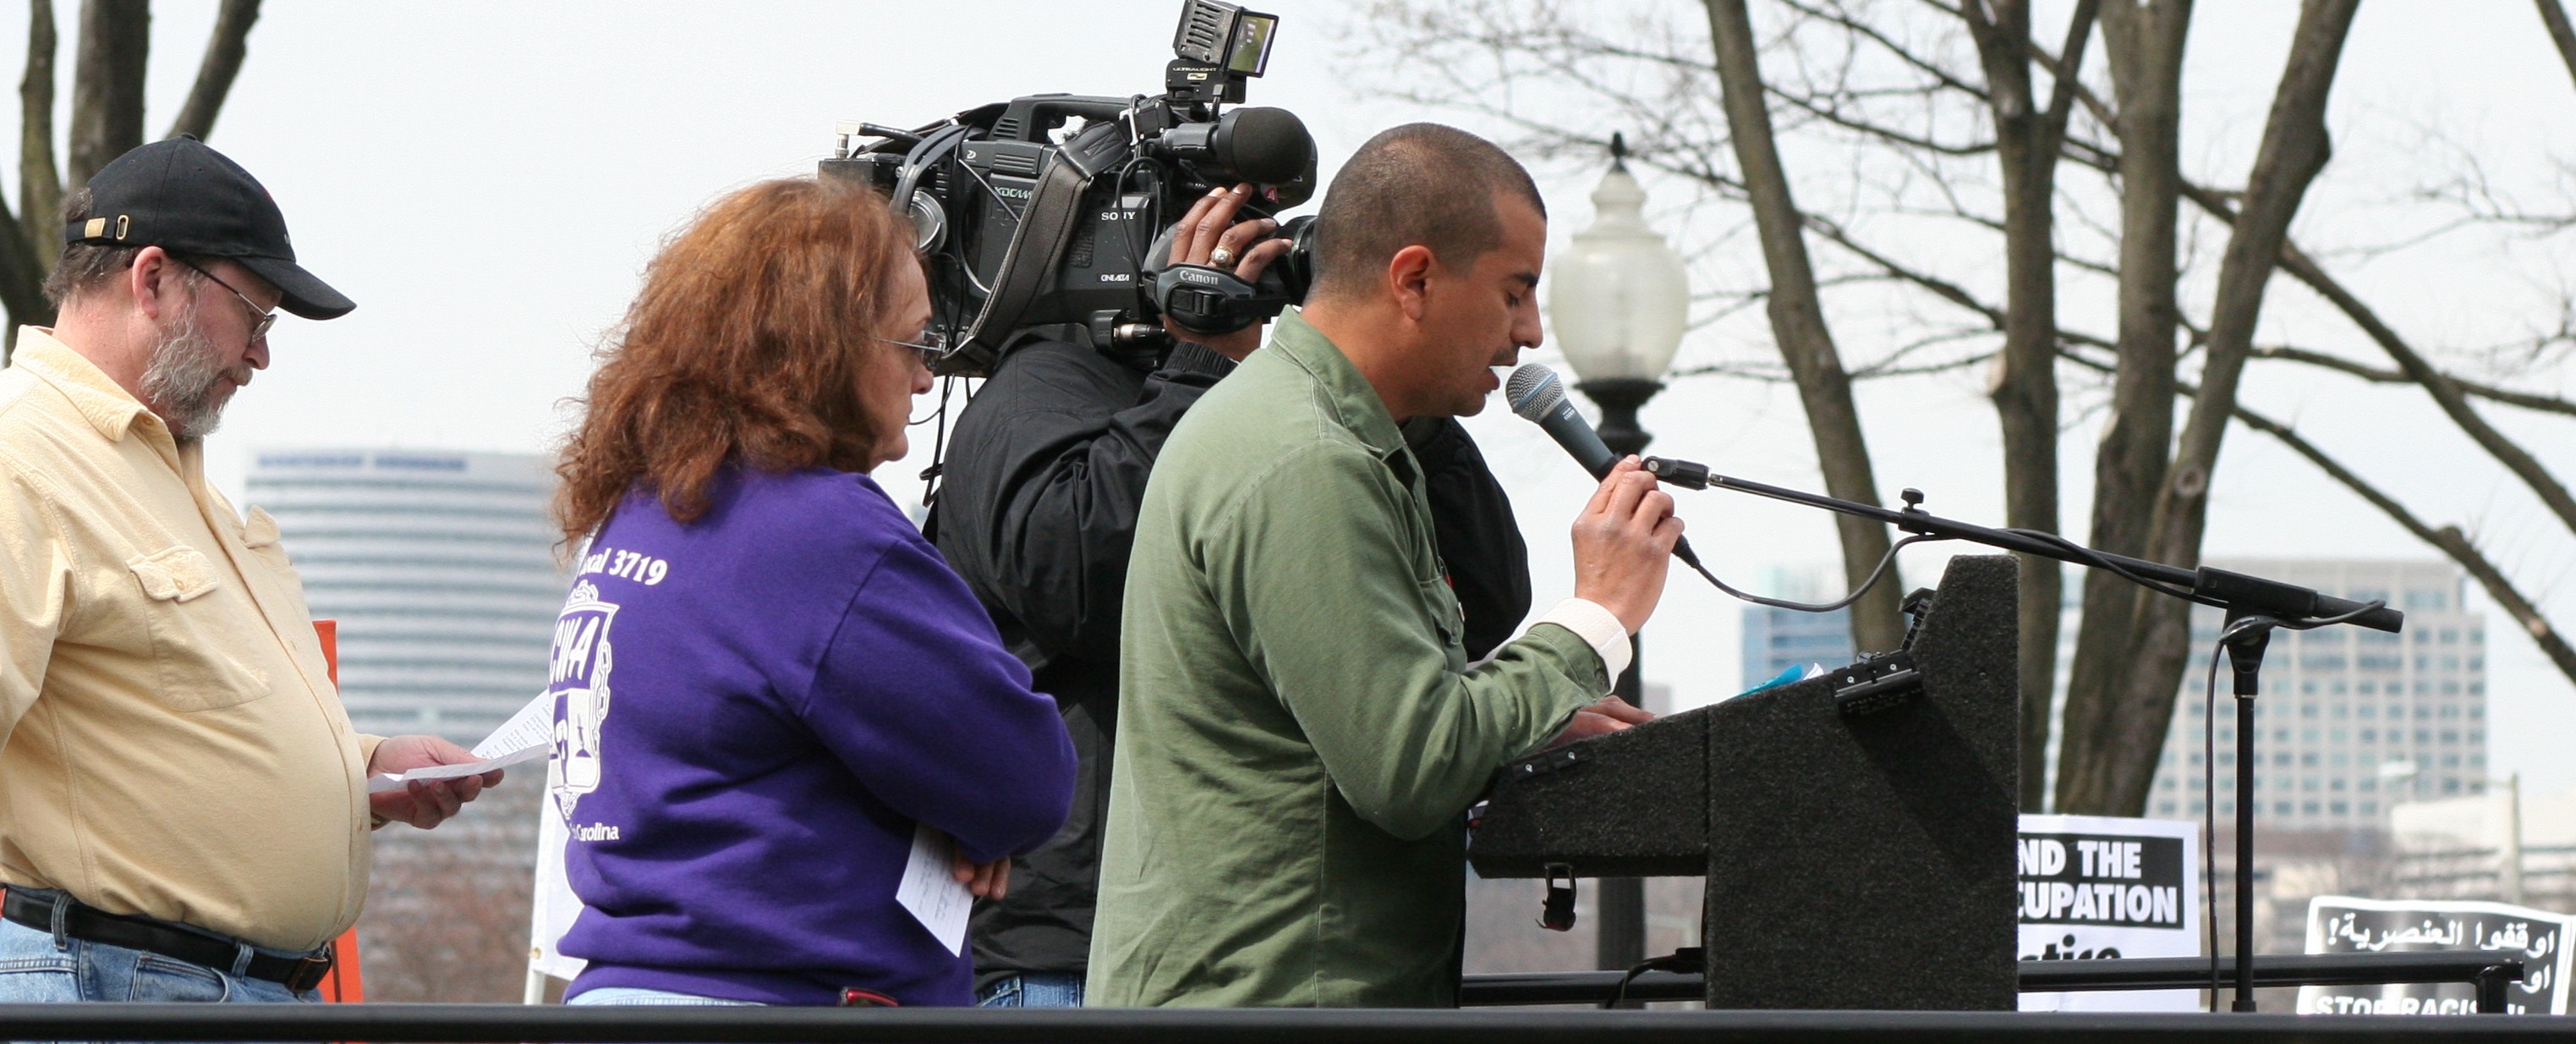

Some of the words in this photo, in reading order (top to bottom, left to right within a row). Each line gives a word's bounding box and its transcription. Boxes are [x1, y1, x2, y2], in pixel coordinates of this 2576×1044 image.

[1180, 271, 1218, 284] Canon
[609, 549, 667, 585] 3719
[2018, 839, 2066, 876] ND
[2077, 839, 2141, 878] THE
[2018, 882, 2177, 923] UPATION
